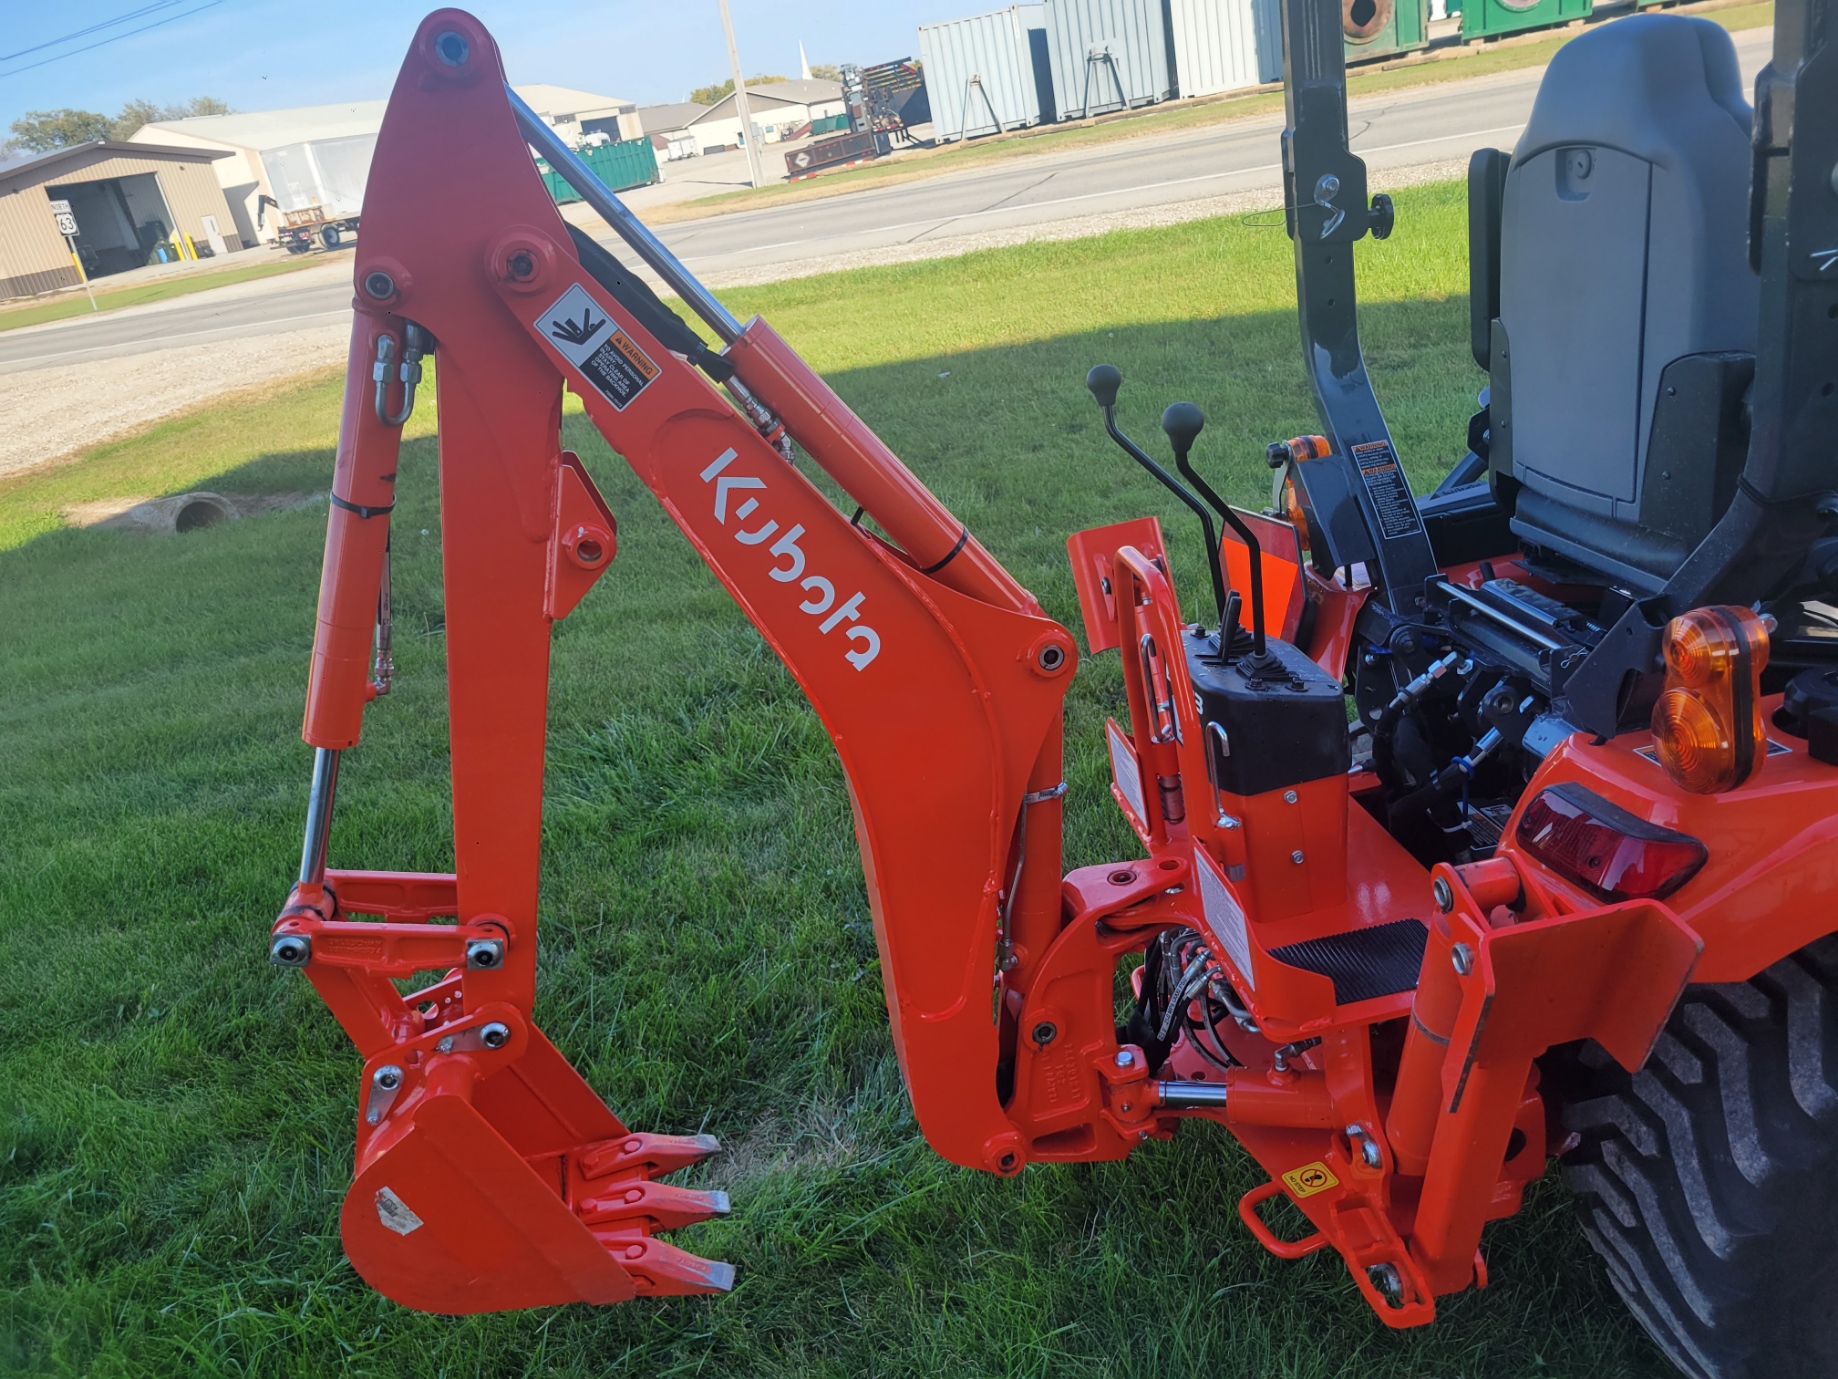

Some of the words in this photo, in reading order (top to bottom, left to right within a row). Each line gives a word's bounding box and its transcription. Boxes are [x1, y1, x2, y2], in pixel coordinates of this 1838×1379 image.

[60, 217, 74, 231] 63
[598, 353, 609, 364] STAY
[609, 365, 623, 378] CLEAR
[609, 350, 623, 364] AVOID
[622, 363, 644, 386] PERSONAL
[622, 342, 653, 375] WARNING
[595, 357, 618, 380] OPERATING
[617, 380, 629, 392] AREA
[597, 367, 607, 376] THE
[606, 375, 627, 397] BACKHOE.
[699, 447, 881, 672] Kubota
[1295, 1181, 1306, 1192] STEP
